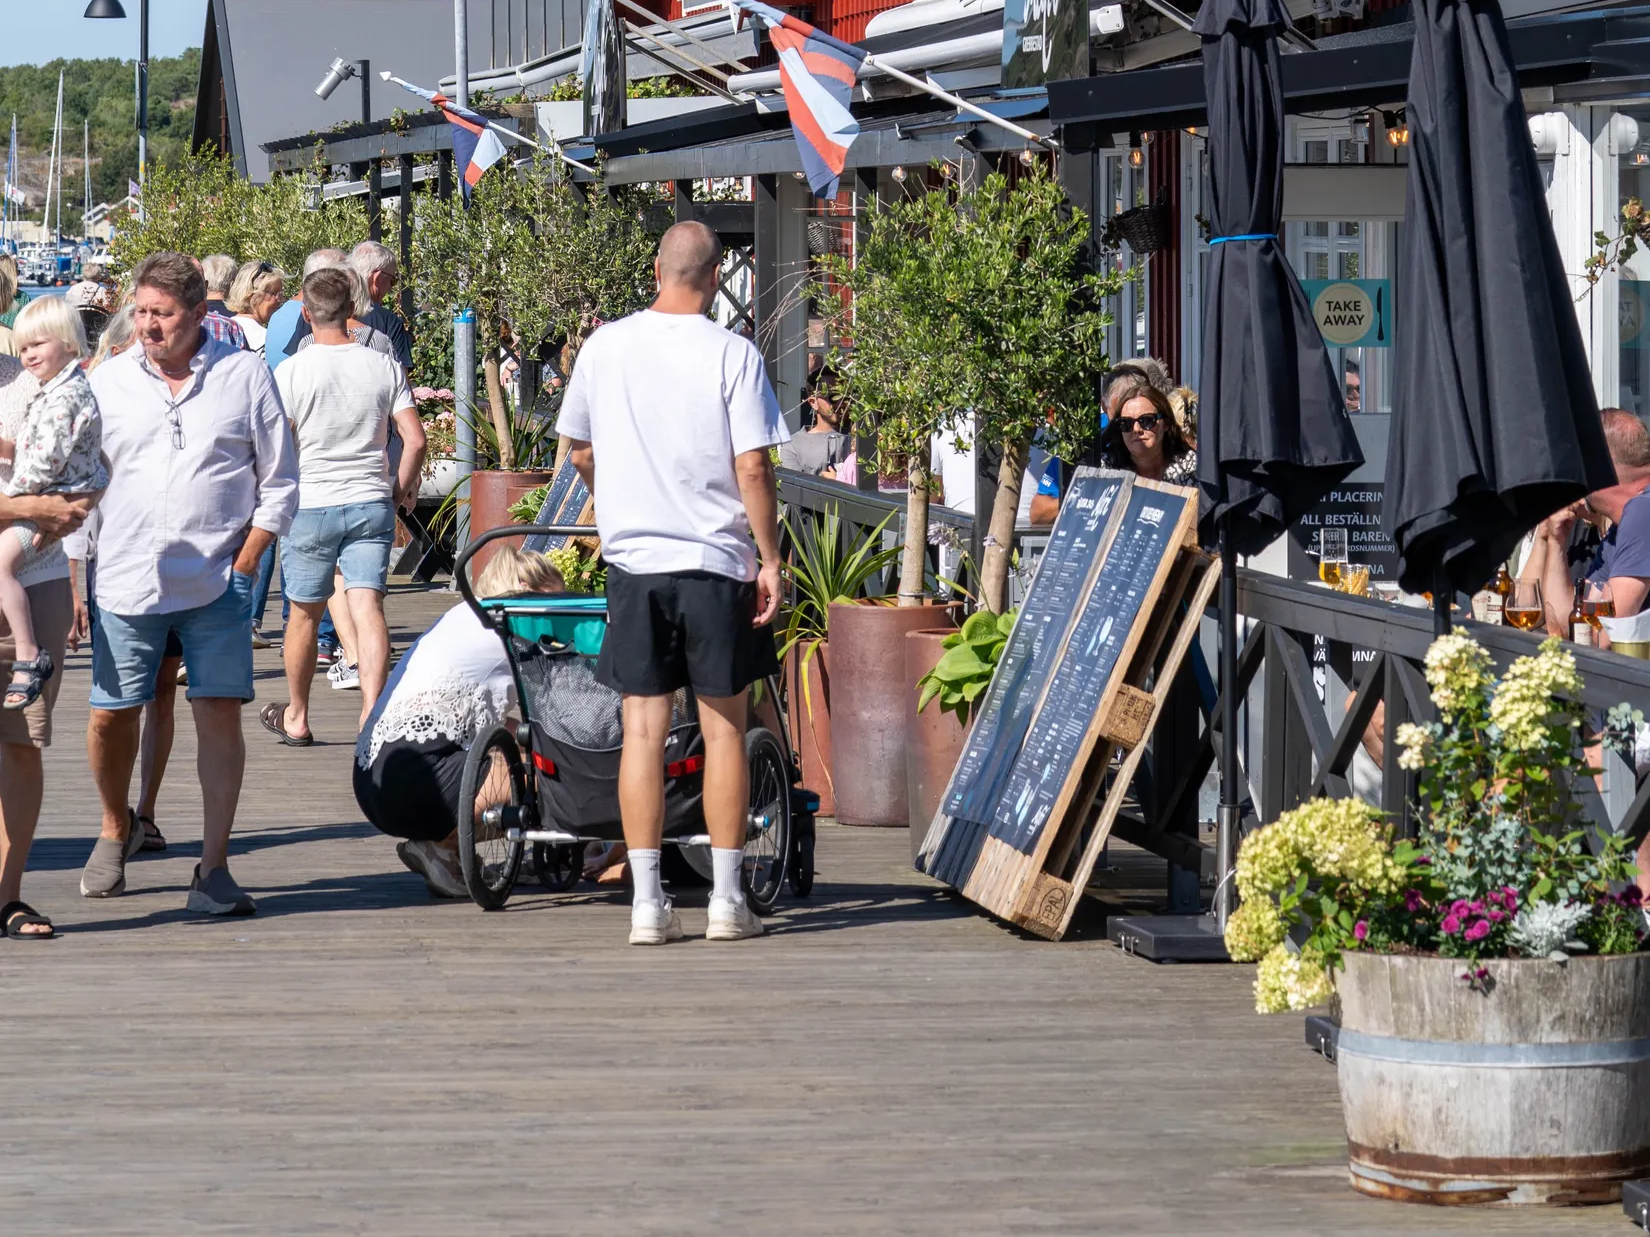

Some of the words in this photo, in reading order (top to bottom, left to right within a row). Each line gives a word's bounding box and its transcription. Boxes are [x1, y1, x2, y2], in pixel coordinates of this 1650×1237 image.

[1326, 301, 1361, 311] TAKE
[1323, 315, 1365, 325] AWAY
[1330, 492, 1384, 502] PLACERIN
[1301, 515, 1321, 524] ALL
[1325, 512, 1380, 524] BESTÄLLN
[1352, 532, 1391, 542] BAREN
[1347, 544, 1395, 553] RDSNUMMER)
[1042, 896, 1063, 920] EPAL
